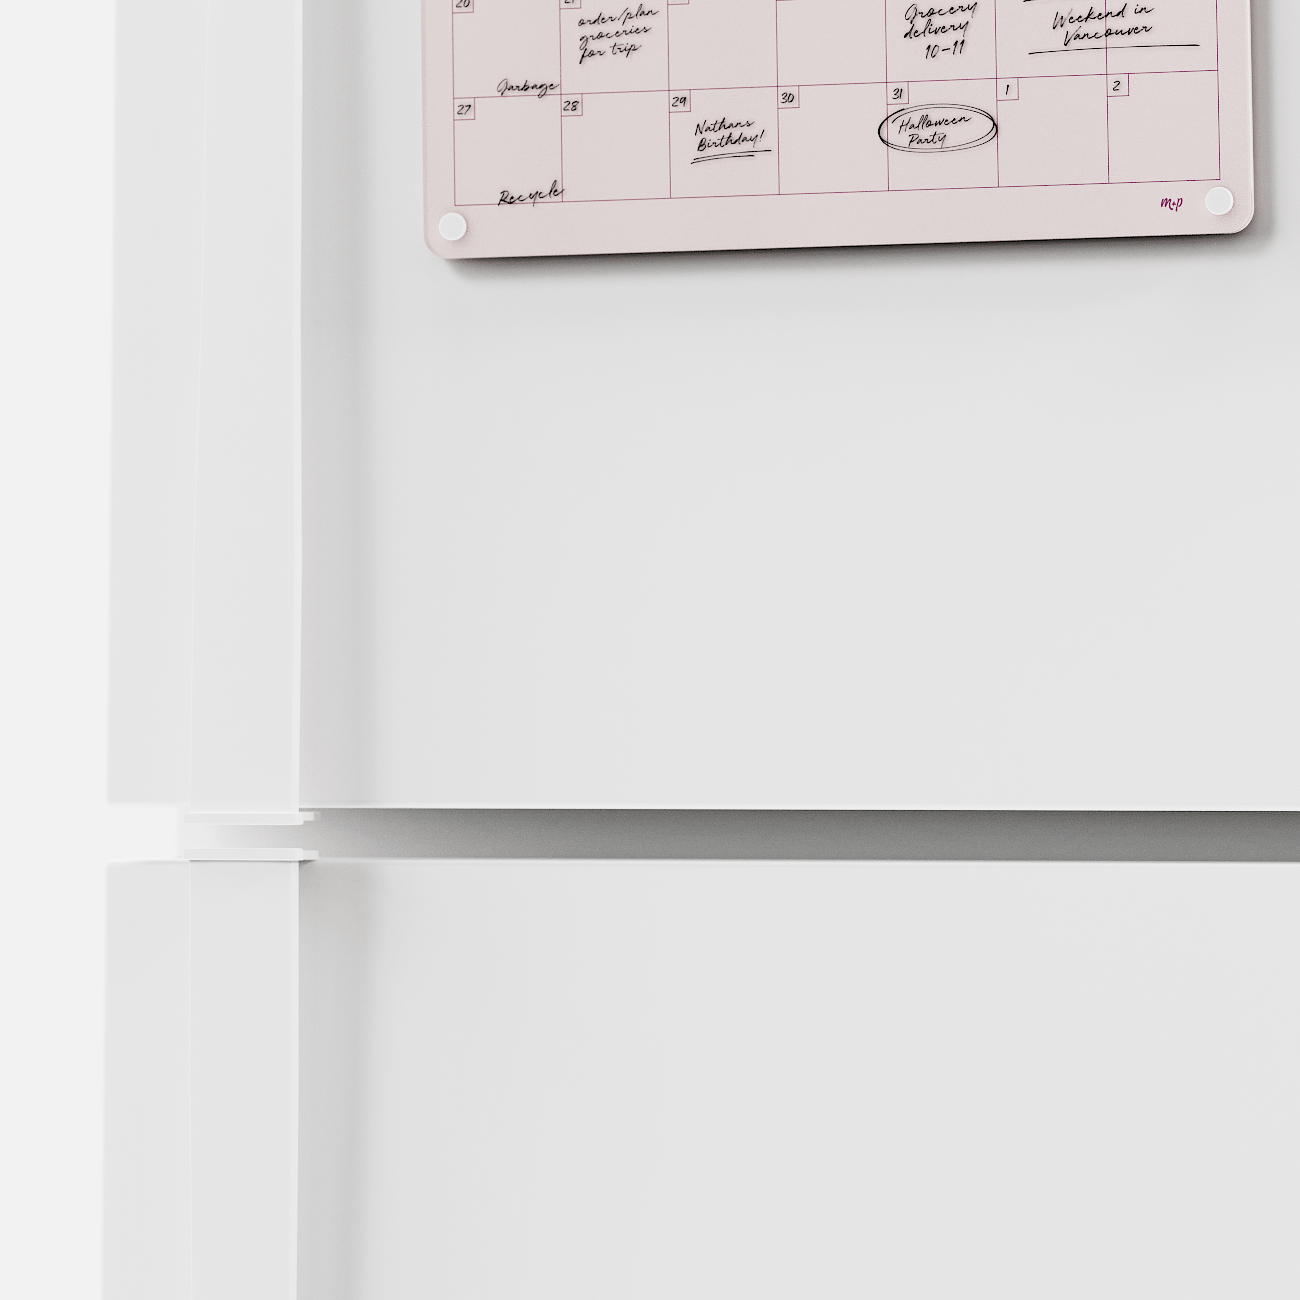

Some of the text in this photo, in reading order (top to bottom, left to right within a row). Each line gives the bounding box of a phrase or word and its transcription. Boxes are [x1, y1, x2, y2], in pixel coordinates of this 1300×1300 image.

[578, 5, 658, 29] order/plan
[904, 1, 978, 22] Grocery
[1052, 3, 1155, 31] Weekend in
[578, 23, 651, 43] groceries
[903, 19, 970, 41] delivery
[1062, 23, 1155, 46] Vancouver
[578, 42, 639, 65] for trip
[497, 79, 558, 99] Garbage
[892, 87, 903, 100] 31
[1005, 84, 1010, 96] 1
[1112, 80, 1121, 92] 2
[563, 100, 579, 112] 28
[671, 96, 687, 108] 29
[780, 92, 795, 104] 30
[457, 104, 472, 115] 27
[694, 117, 756, 136] Nathans
[898, 113, 972, 135] Halloween
[696, 129, 766, 153] Birthday!
[907, 133, 948, 148] Party
[497, 179, 565, 207] Recycle
